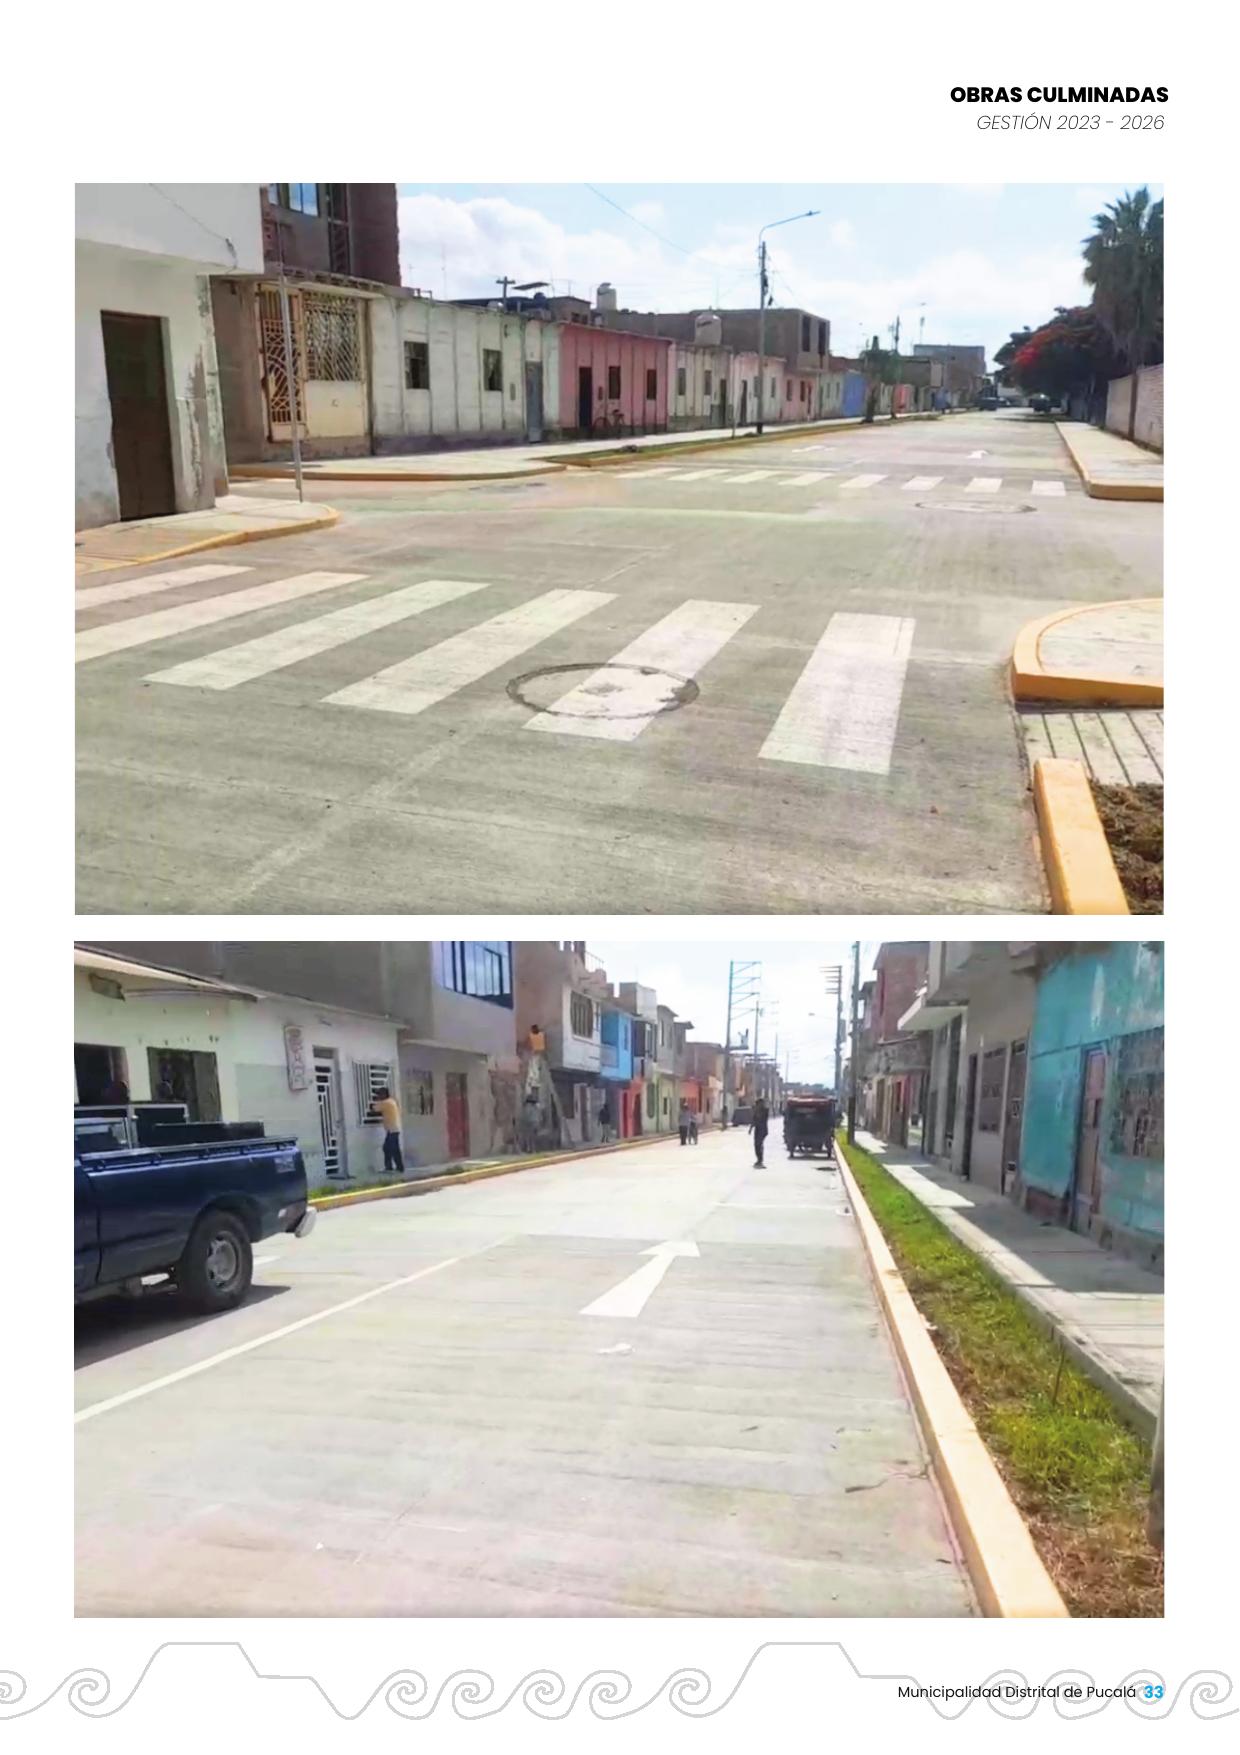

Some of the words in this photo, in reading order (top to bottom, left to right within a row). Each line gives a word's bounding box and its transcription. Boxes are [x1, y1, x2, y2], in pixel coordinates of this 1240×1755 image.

[950, 86, 1023, 103] OBRAS
[1026, 86, 1169, 103] CULMINADAS
[976, 111, 1052, 130] GESTIÓN
[1056, 114, 1101, 130] 2023
[1119, 114, 1165, 130] 2026
[898, 1685, 1001, 1702] Municipalidad
[1005, 1685, 1060, 1698] Distrital
[1063, 1685, 1083, 1698] de
[1087, 1685, 1136, 1698] Pucalá
[1144, 1684, 1164, 1699] 33
